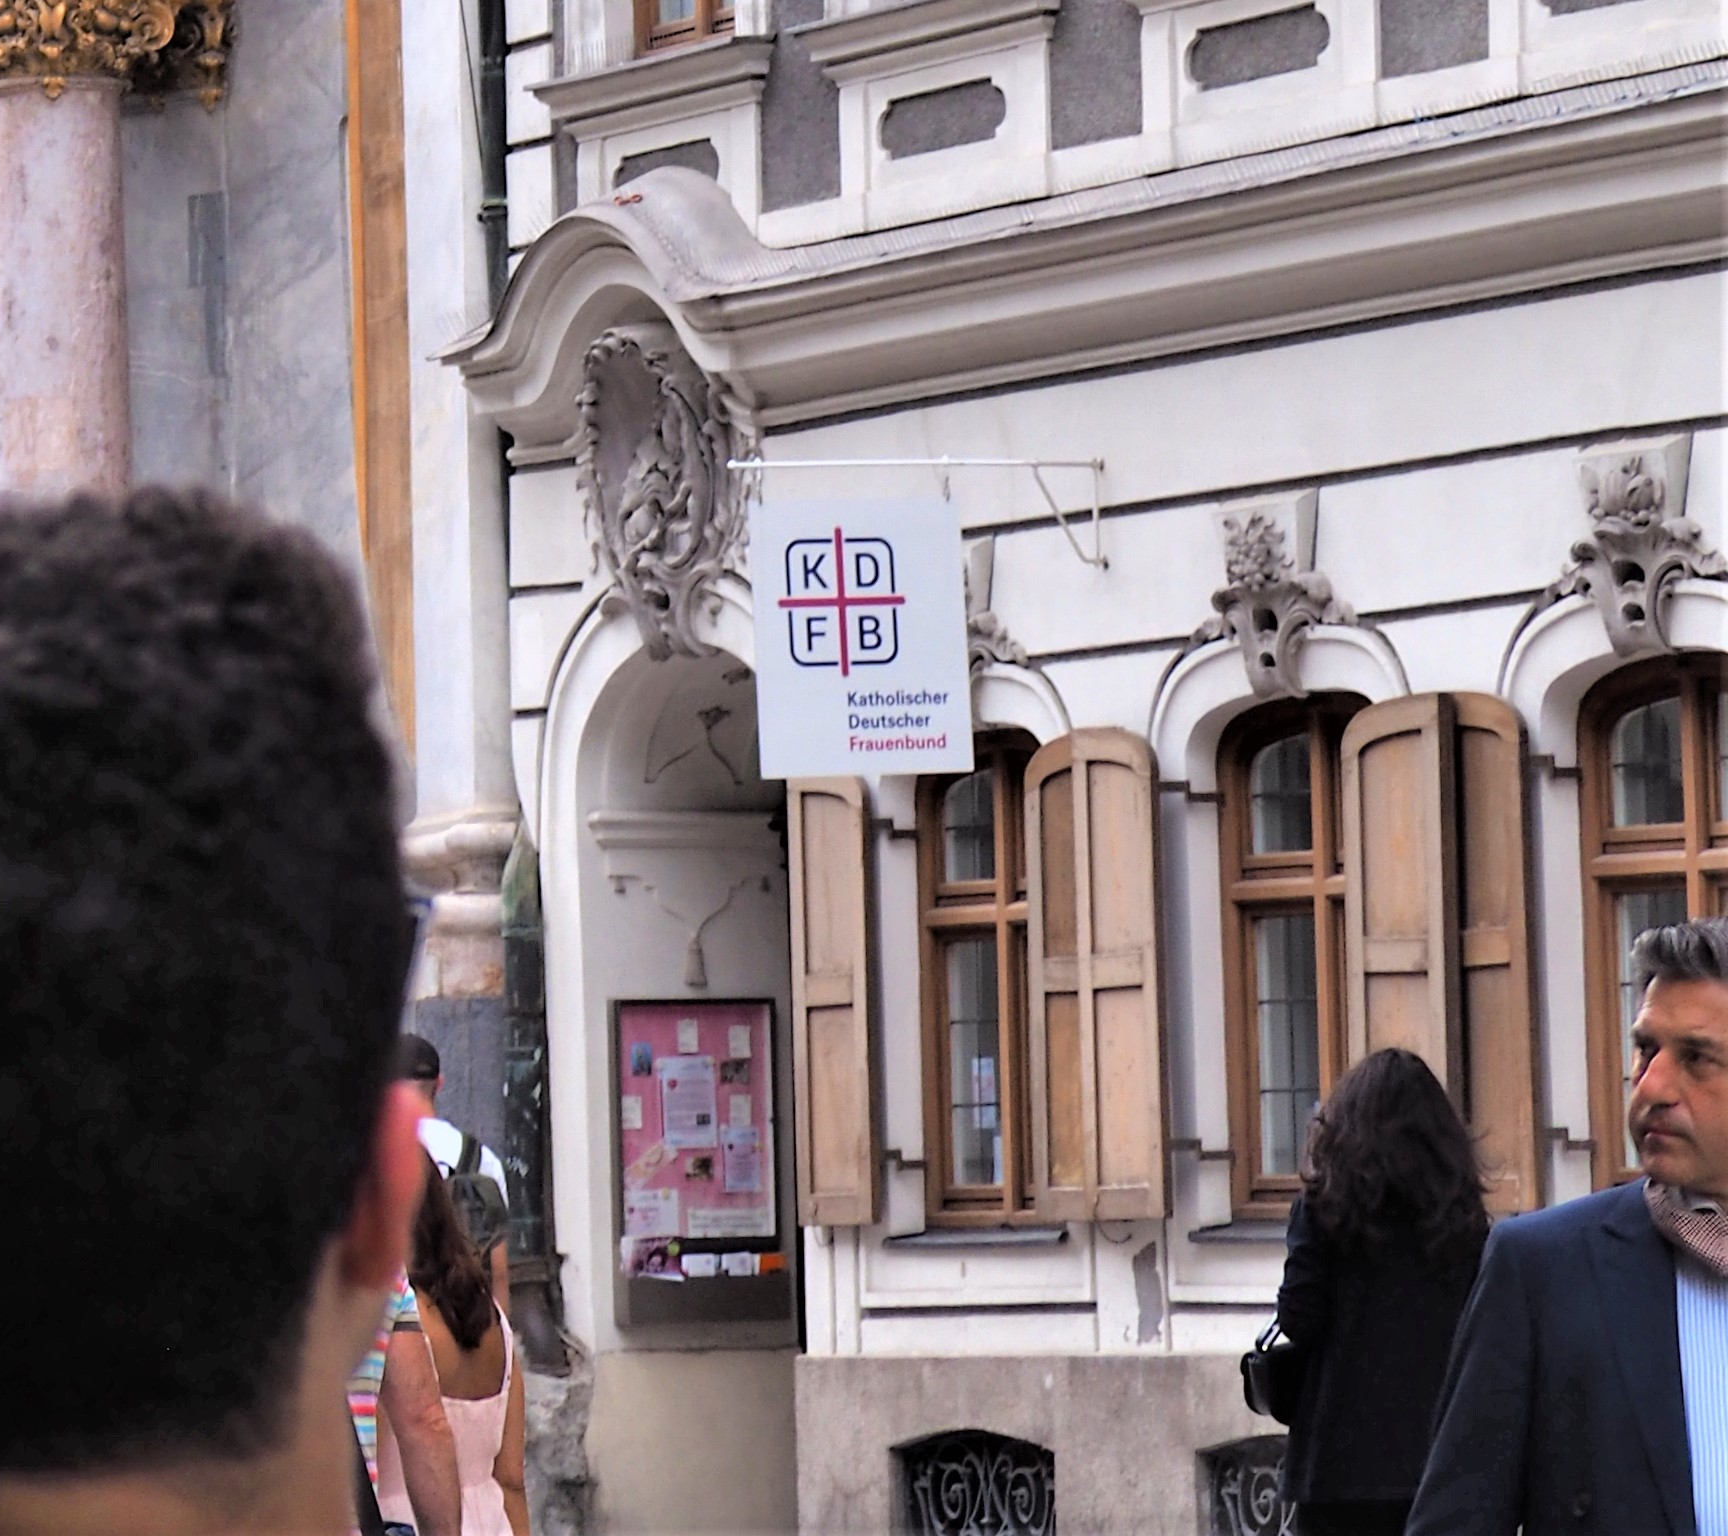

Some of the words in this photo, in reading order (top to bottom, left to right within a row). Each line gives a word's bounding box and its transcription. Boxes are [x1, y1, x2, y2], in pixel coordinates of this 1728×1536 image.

[847, 690, 949, 708] Katholischer
[848, 714, 931, 730] Deutscher
[849, 734, 947, 752] Frauenbund
